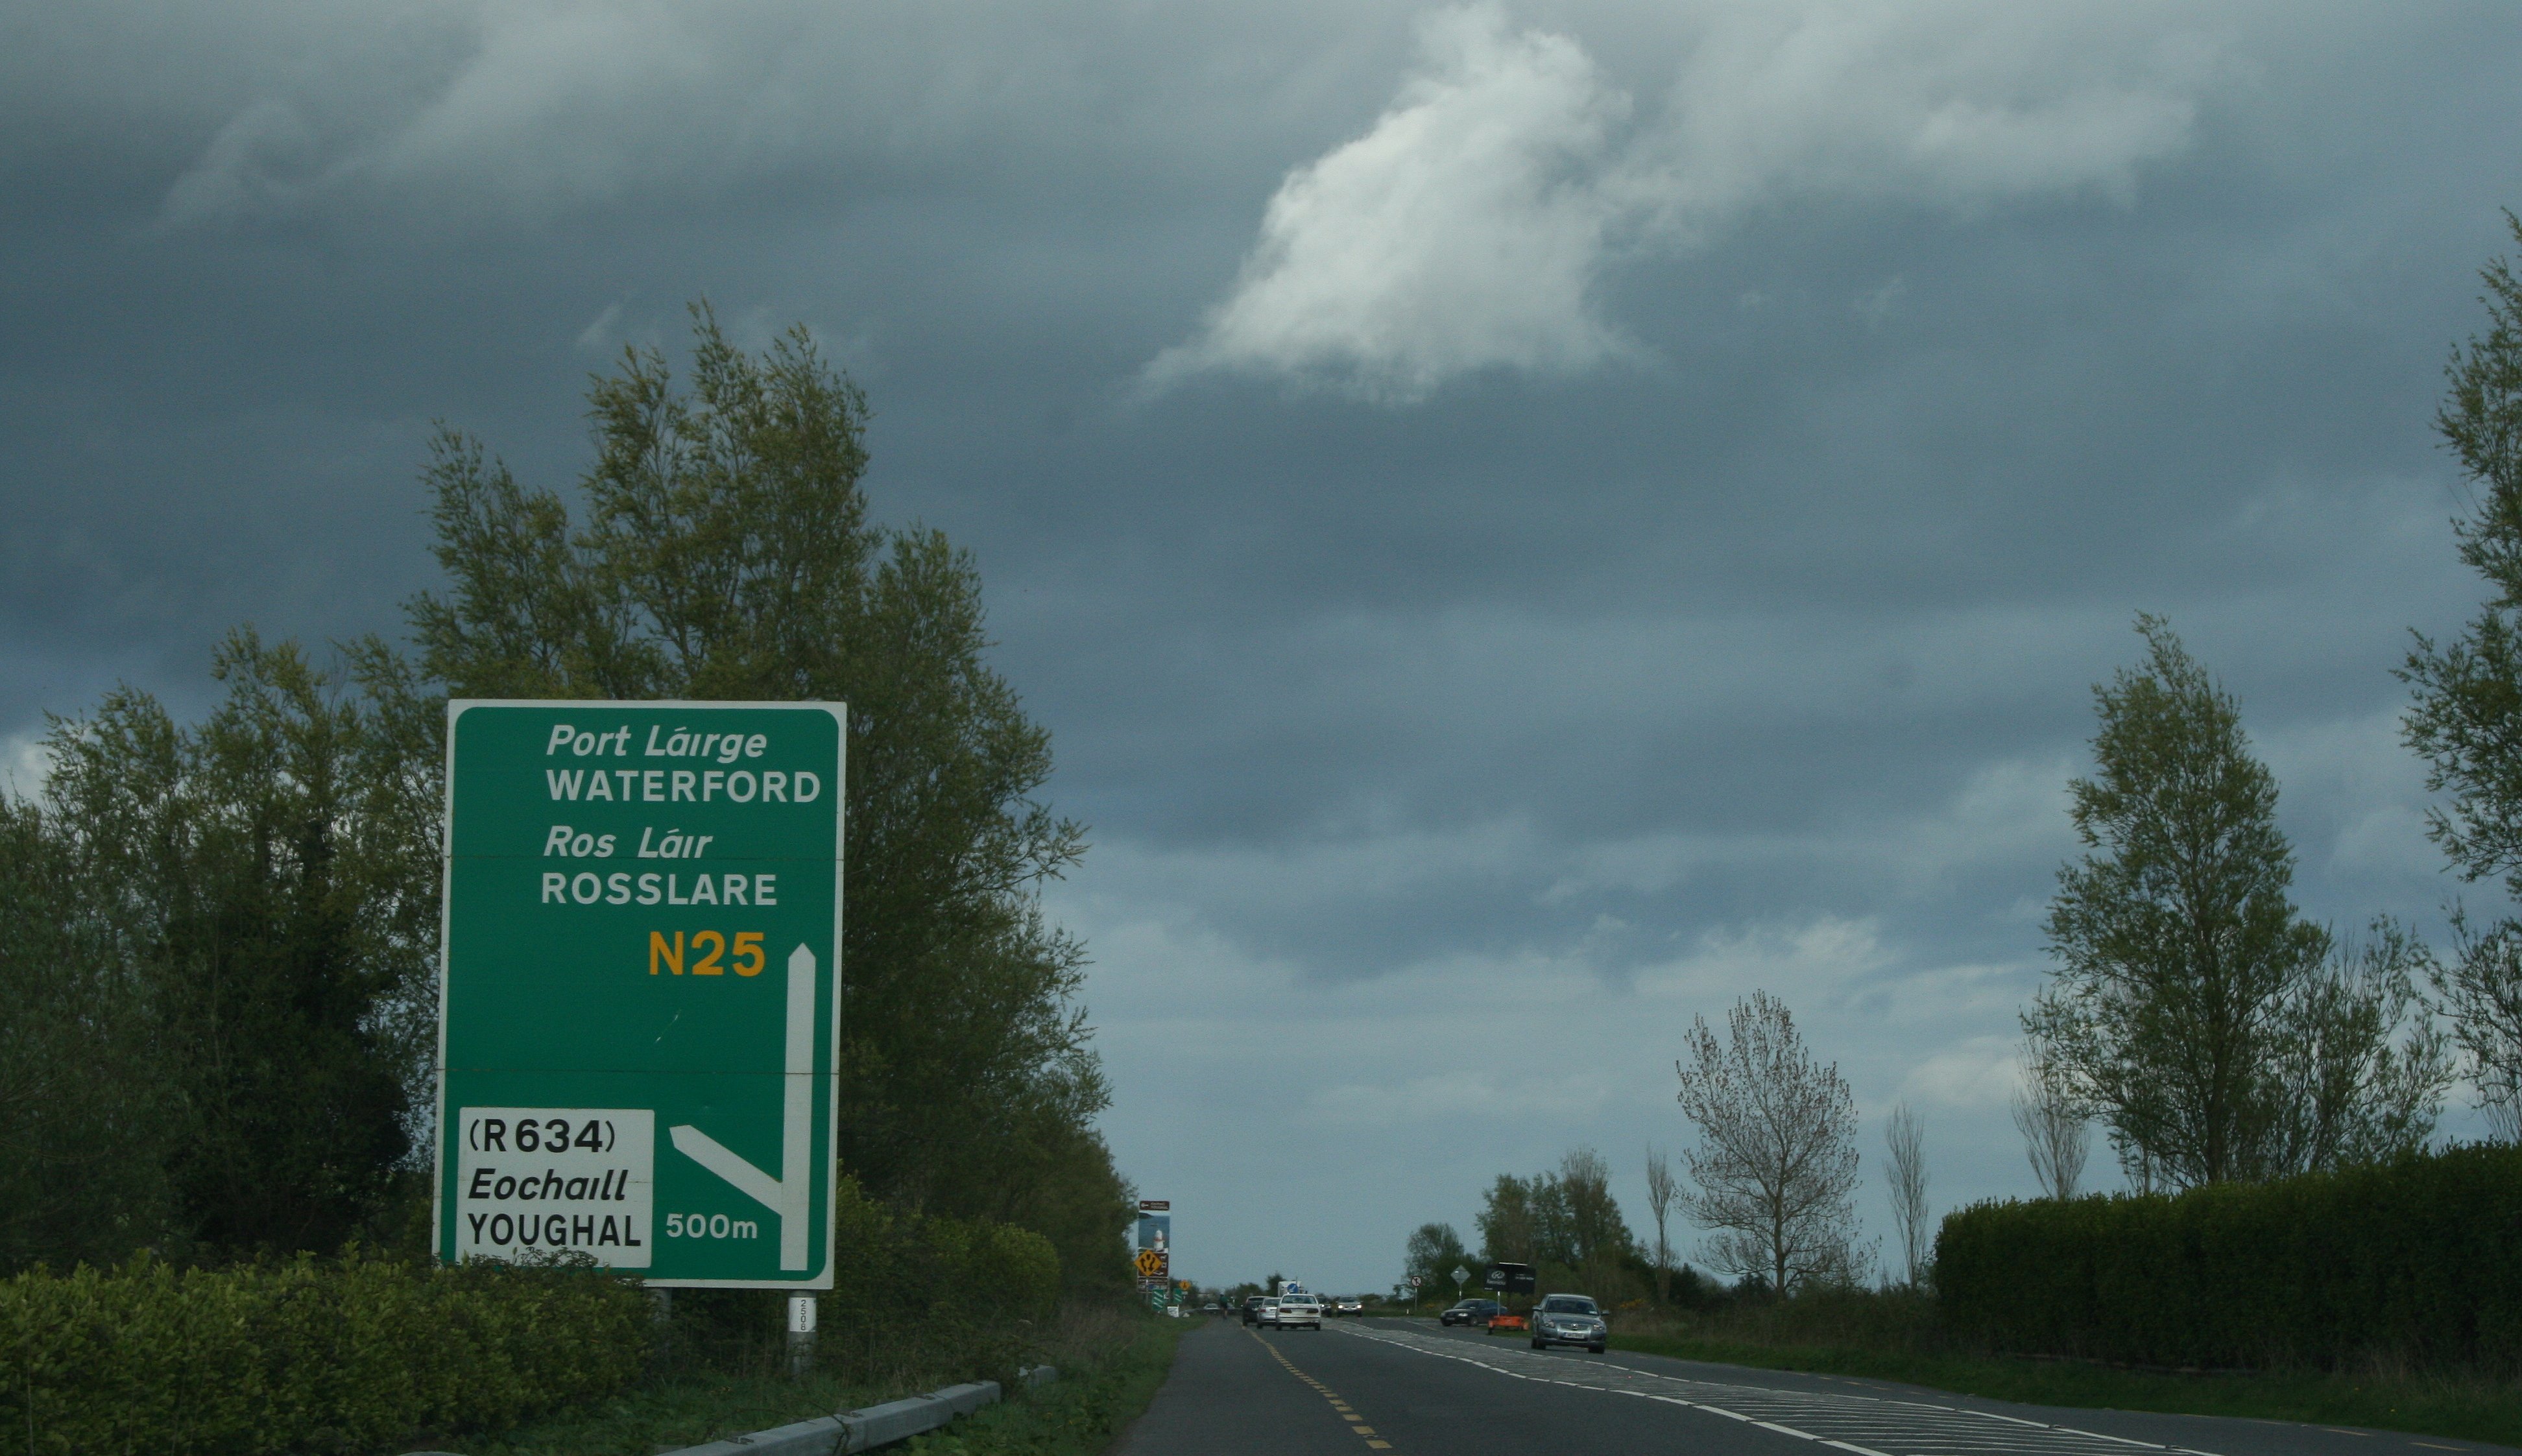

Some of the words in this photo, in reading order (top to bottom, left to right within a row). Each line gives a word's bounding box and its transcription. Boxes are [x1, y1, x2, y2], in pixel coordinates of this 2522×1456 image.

[546, 724, 632, 756] Port
[546, 769, 821, 803] WATERFORD
[543, 825, 617, 857] Ros
[542, 872, 777, 905] ROSSLARE
[649, 929, 765, 977] N25
[467, 1213, 642, 1247] YOUGHAL
[666, 1213, 758, 1239] 500m
